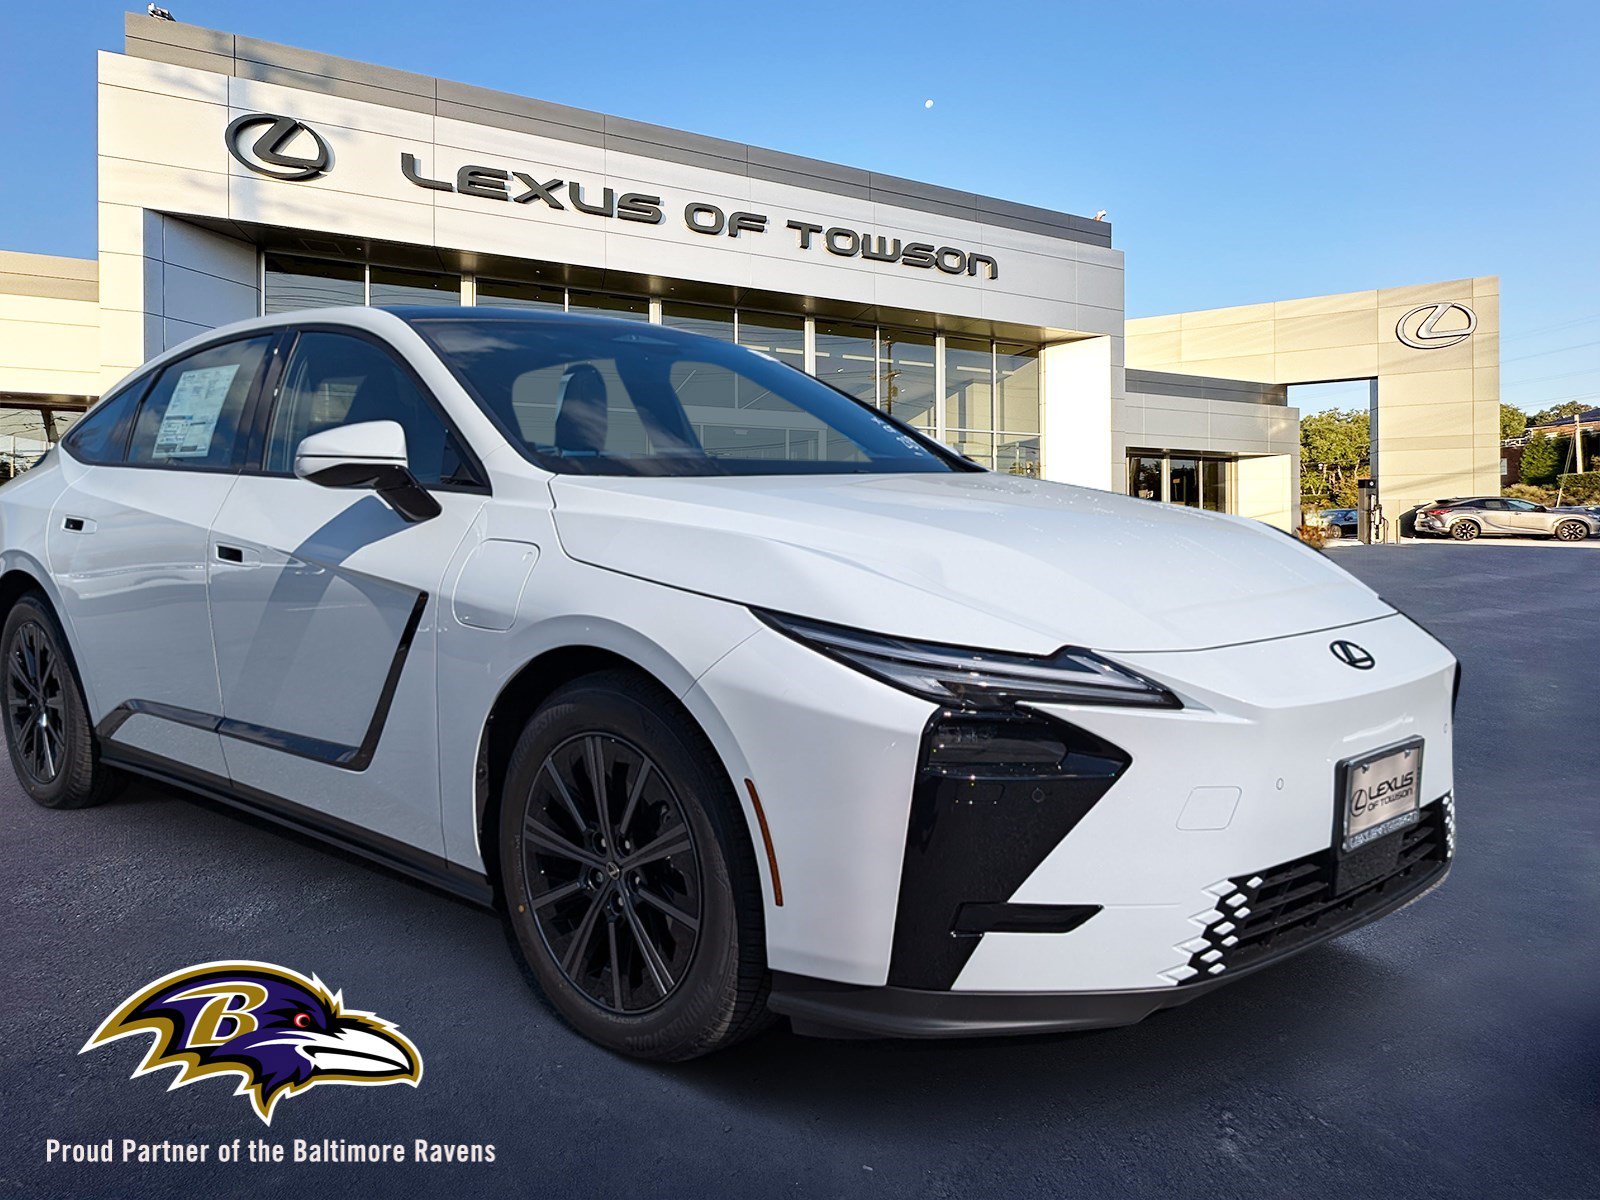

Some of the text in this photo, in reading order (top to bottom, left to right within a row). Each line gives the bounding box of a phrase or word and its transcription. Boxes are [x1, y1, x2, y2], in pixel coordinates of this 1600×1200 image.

[401, 152, 999, 280] LEXUS OF TOWSON
[1369, 771, 1414, 800] LEXUS
[1368, 800, 1379, 811] OF
